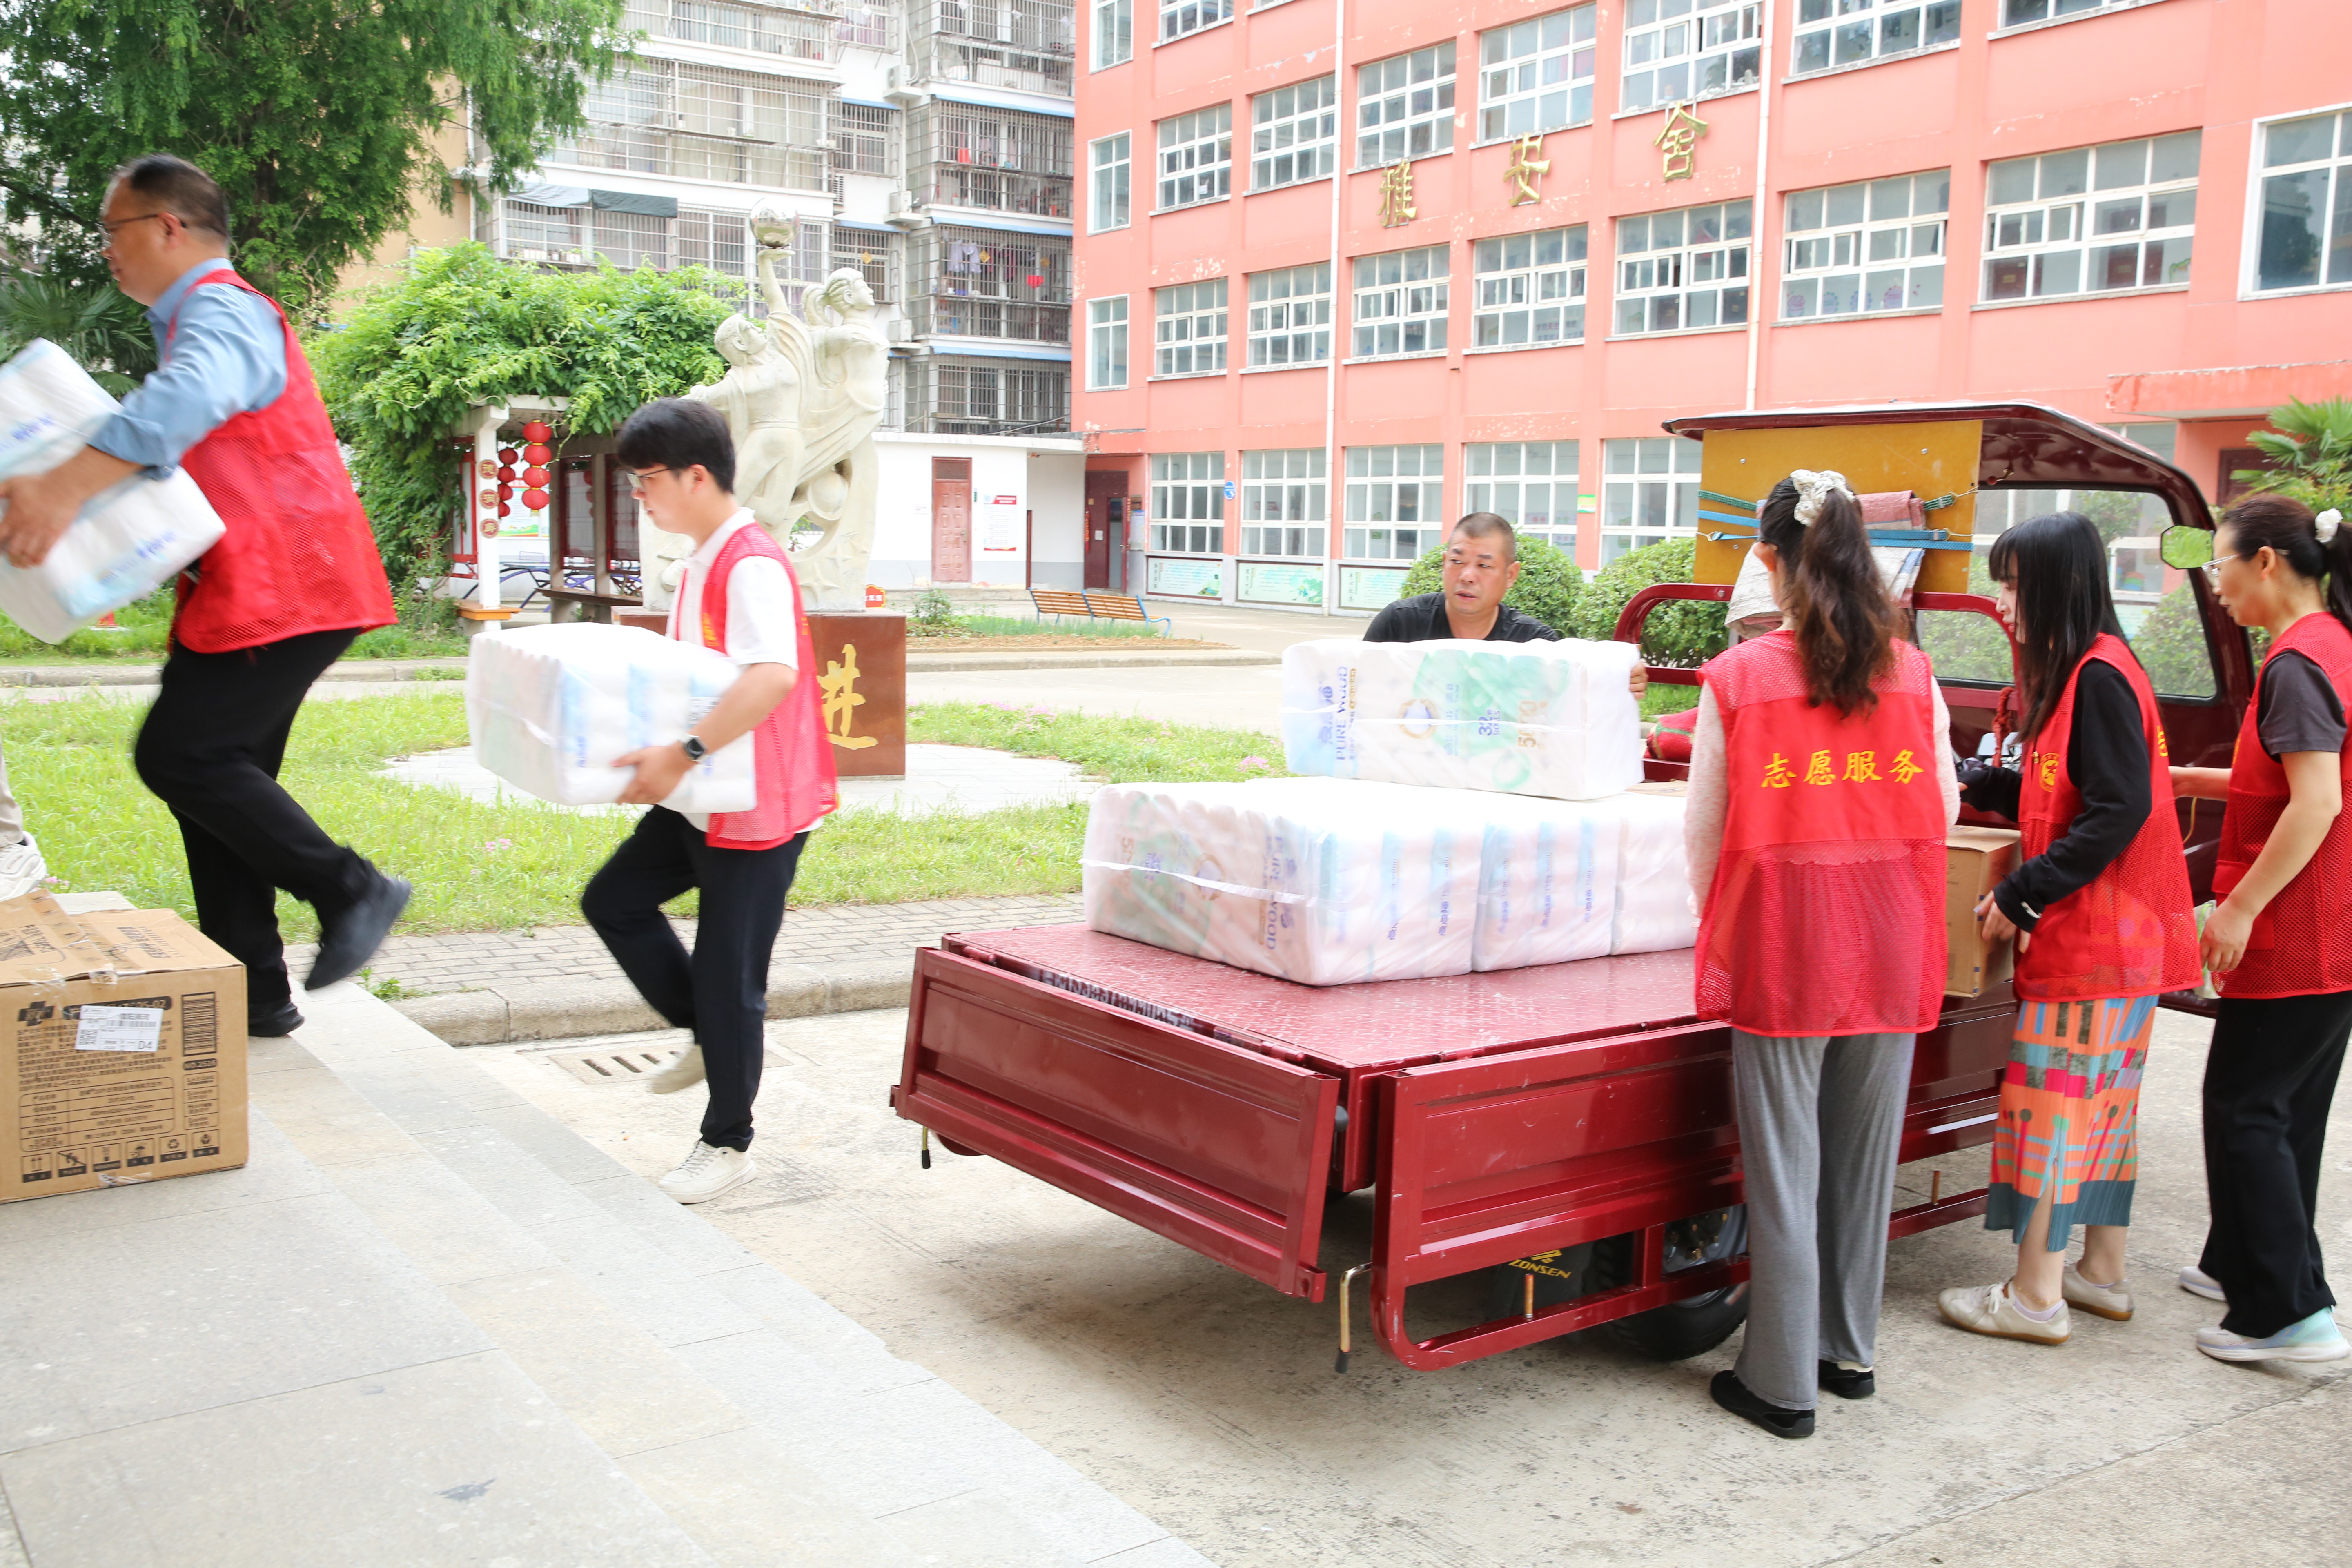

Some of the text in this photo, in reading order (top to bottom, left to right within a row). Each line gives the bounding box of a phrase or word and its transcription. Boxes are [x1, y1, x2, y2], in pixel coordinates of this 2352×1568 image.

[1761, 749, 1925, 788] 志愿服务
[138, 1040, 152, 1049] D4
[1508, 1259, 1572, 1278] LONSEN
